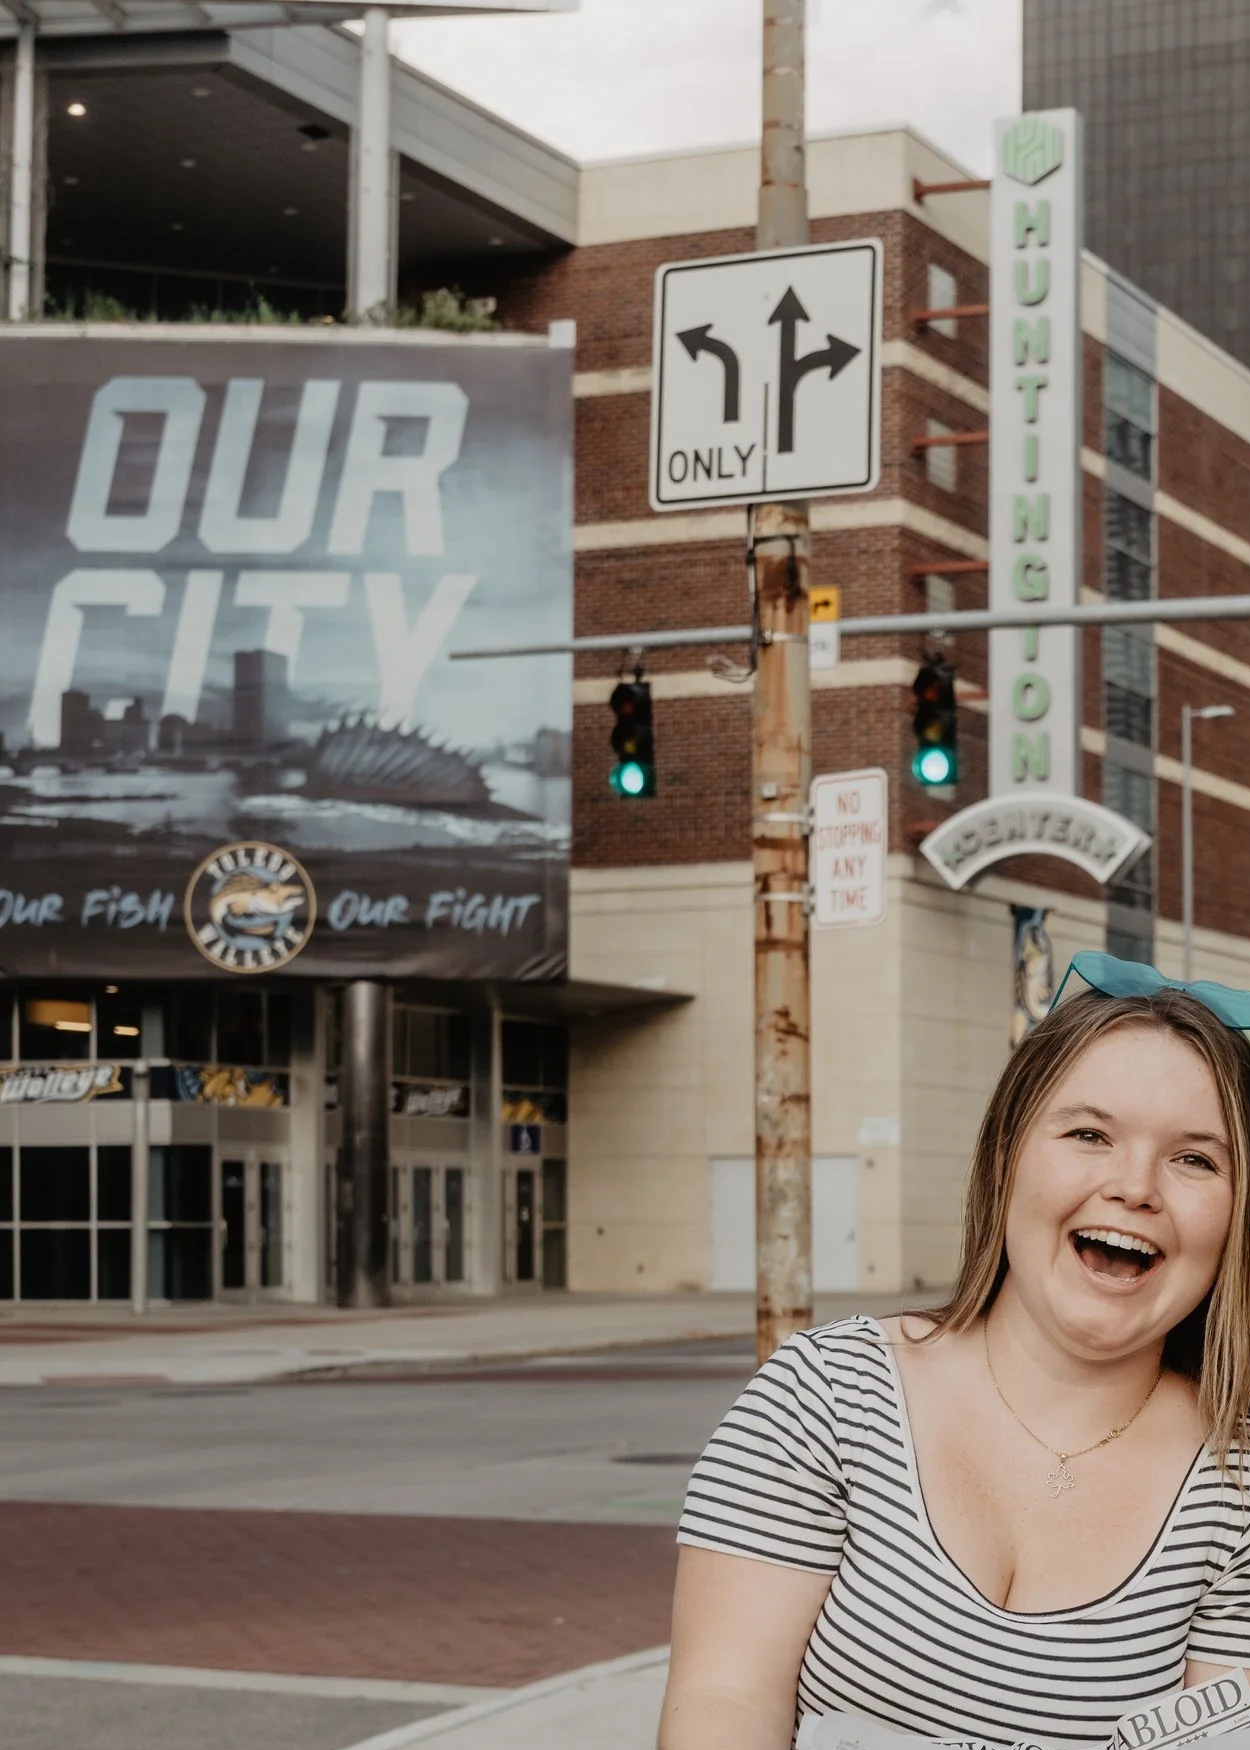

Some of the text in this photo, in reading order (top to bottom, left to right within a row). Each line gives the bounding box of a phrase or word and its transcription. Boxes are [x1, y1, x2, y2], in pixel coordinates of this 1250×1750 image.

[66, 376, 470, 556] OUR
[668, 444, 755, 484] ONLY
[27, 568, 479, 752] CITY
[837, 792, 861, 815] NO
[817, 821, 882, 852] STOPPING
[958, 810, 1096, 855] CENTER
[832, 856, 868, 882] ANY
[830, 887, 869, 912] TIME
